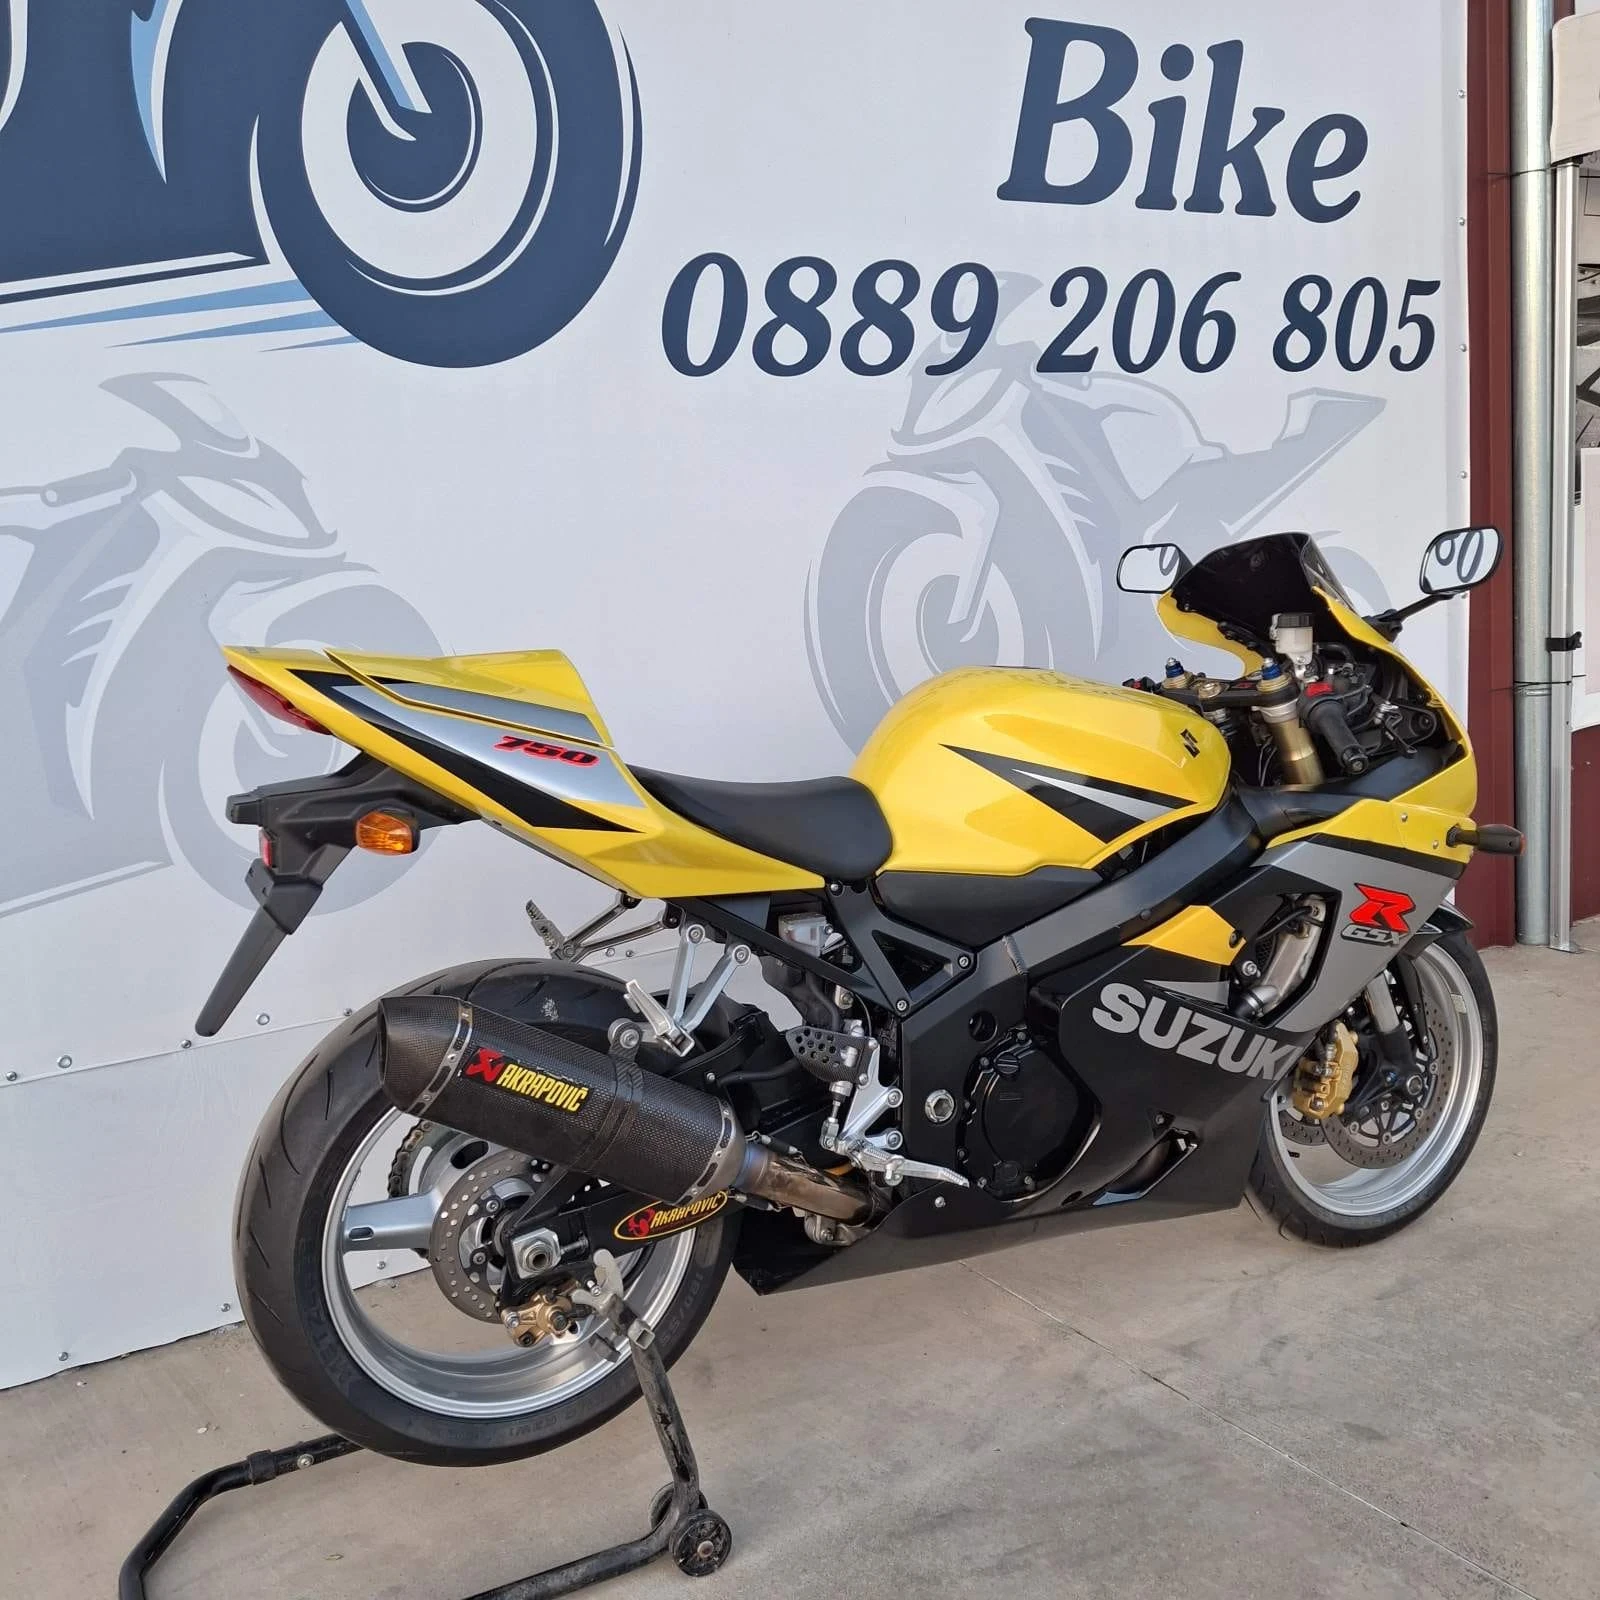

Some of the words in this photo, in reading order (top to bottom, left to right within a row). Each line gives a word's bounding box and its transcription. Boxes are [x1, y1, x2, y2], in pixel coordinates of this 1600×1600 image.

[997, 18, 1367, 223] Bike
[662, 253, 998, 377] 0889
[1036, 267, 1241, 373] 206
[1273, 275, 1440, 372] 805
[493, 736, 599, 768] 750
[1350, 884, 1416, 932] R
[1092, 982, 1304, 1081] SUZUKI
